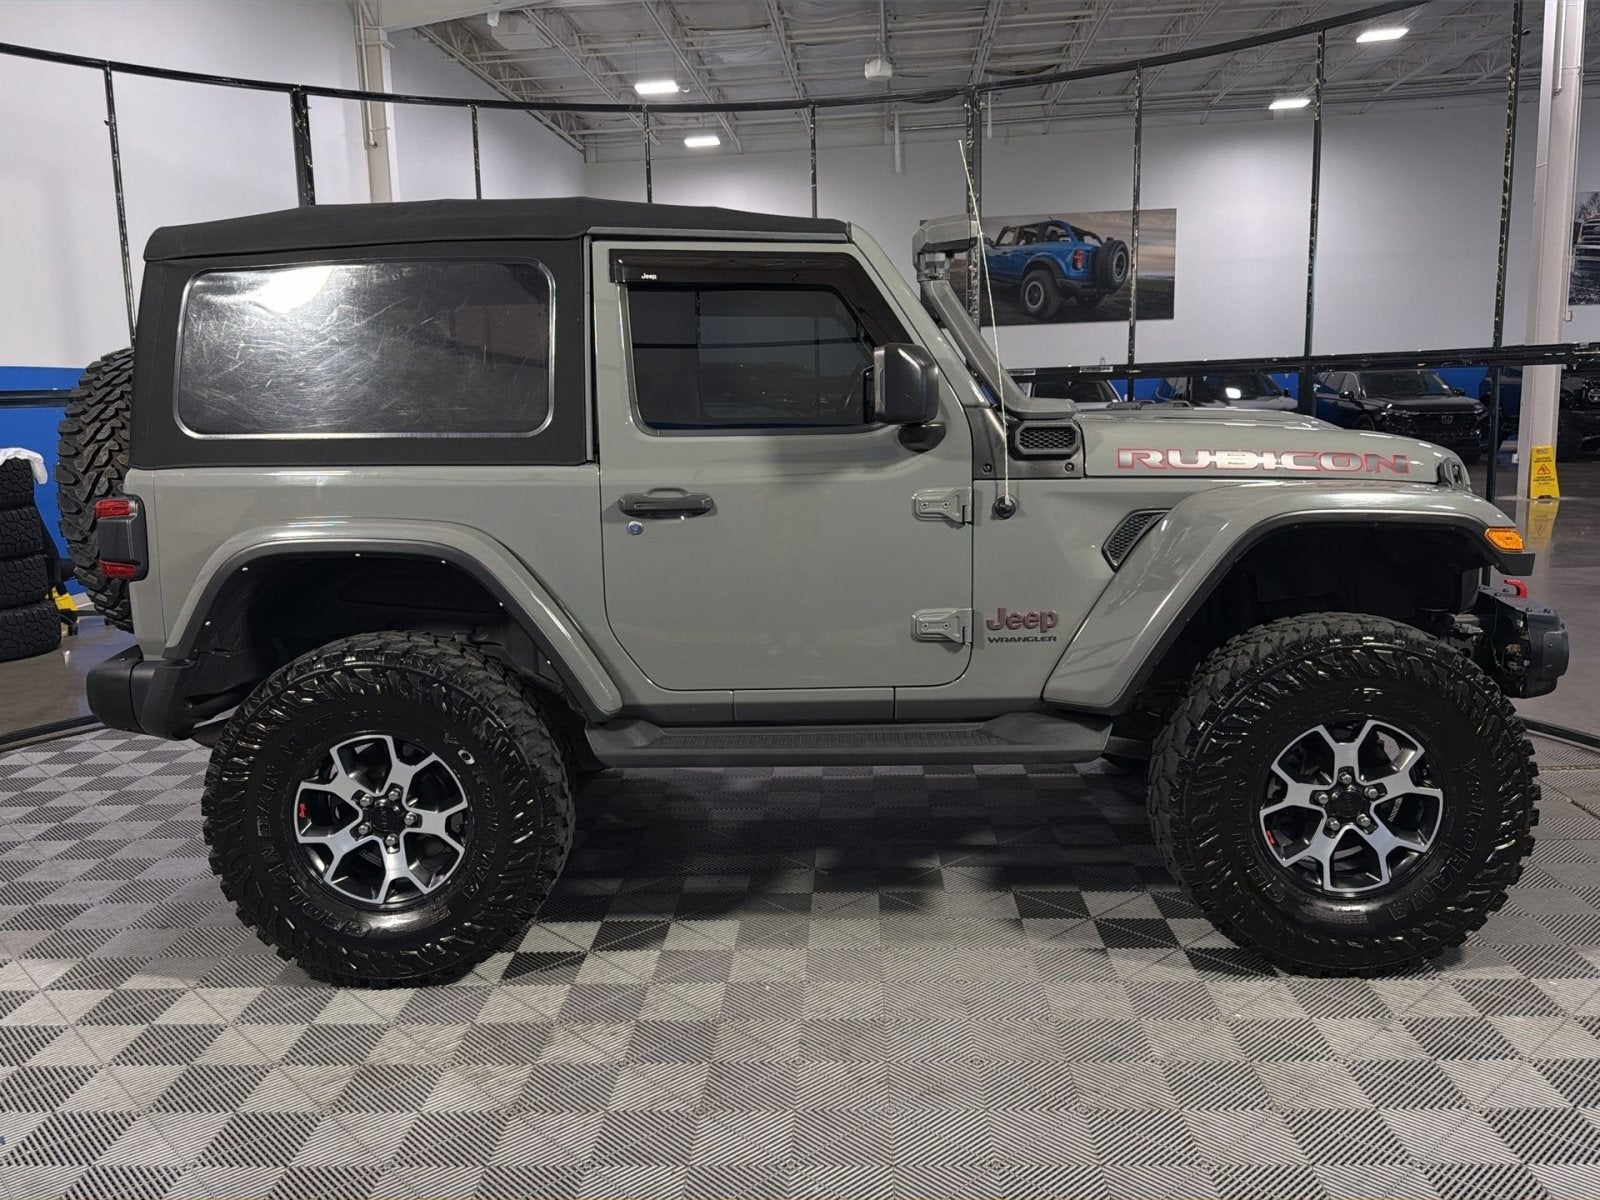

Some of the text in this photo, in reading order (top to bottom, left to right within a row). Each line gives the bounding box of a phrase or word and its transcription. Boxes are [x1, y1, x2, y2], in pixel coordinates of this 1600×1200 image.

[640, 272, 658, 280] Jeep
[1117, 448, 1409, 474] RUBICON
[986, 606, 1059, 633] Jeep
[987, 635, 1057, 643] WRANGLER
[441, 728, 500, 901] YOKOHAMA
[1386, 757, 1486, 921] YOKOHAMA
